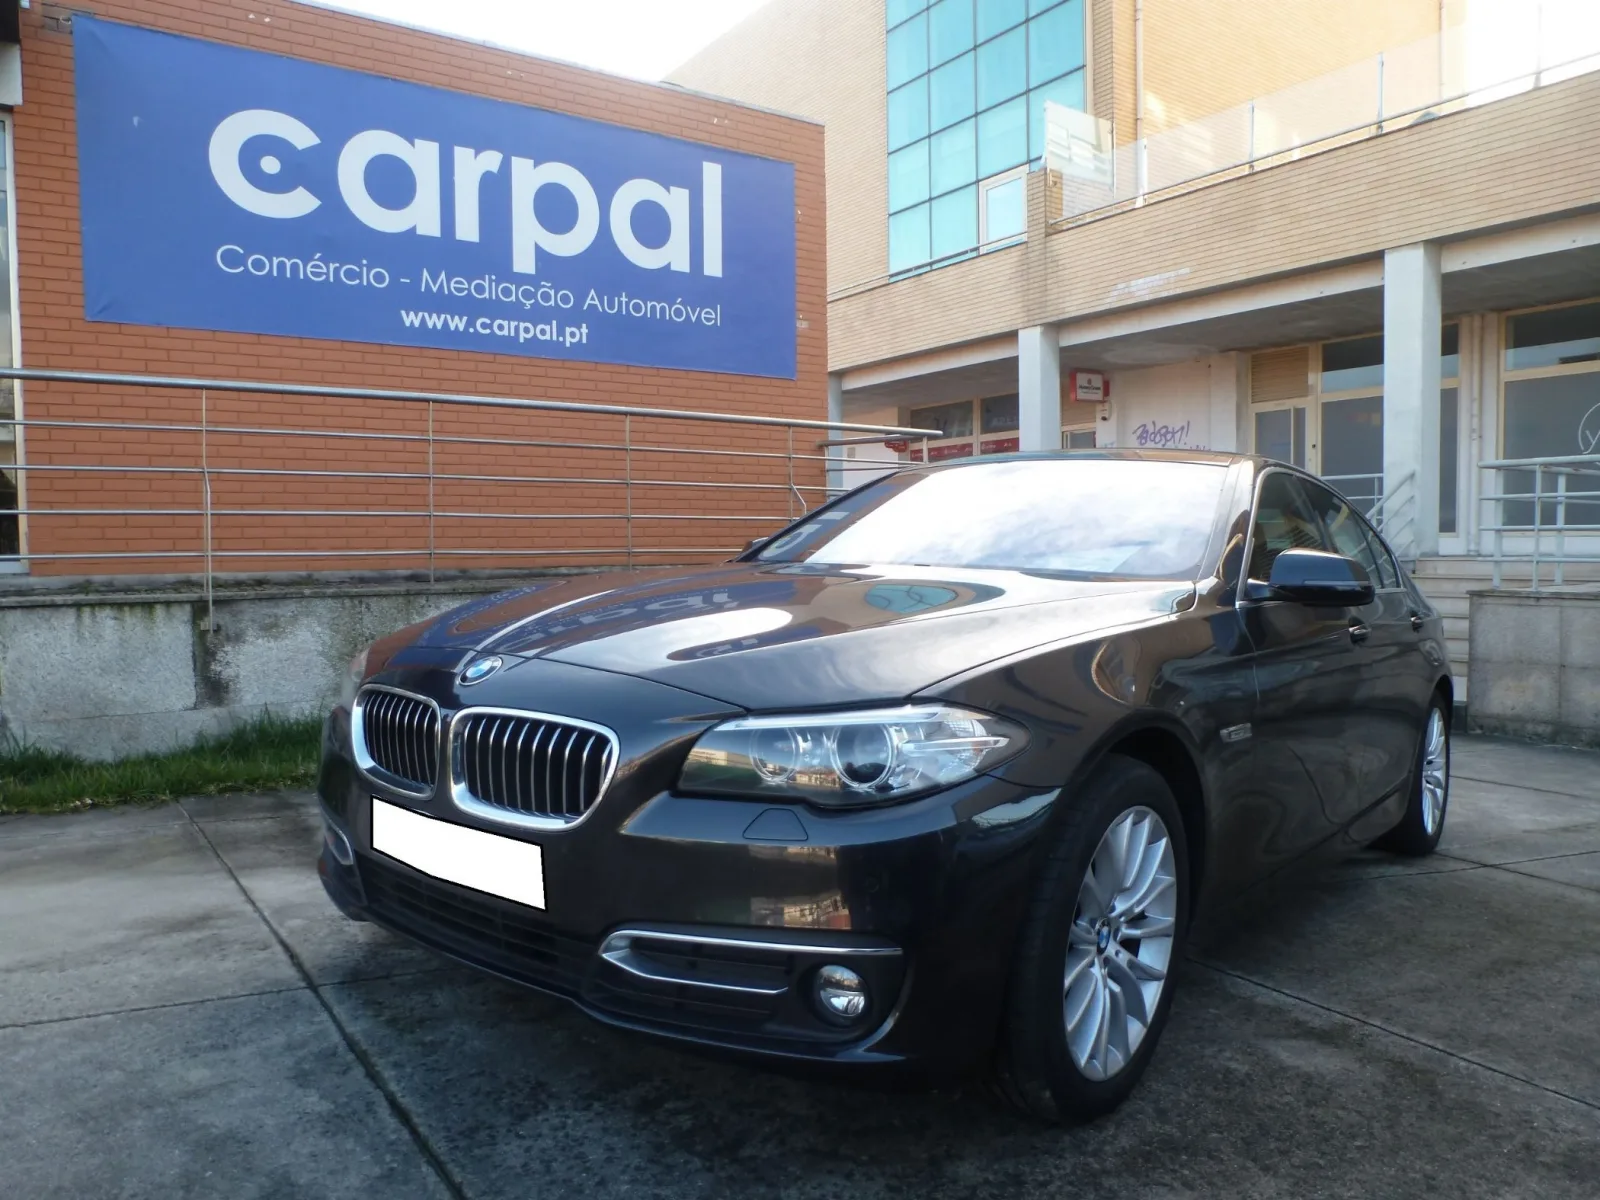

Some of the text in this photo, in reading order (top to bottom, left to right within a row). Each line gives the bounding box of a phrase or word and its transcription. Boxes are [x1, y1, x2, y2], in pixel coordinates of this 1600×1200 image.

[208, 109, 723, 278] carpal
[216, 244, 390, 288] Comércio
[420, 268, 575, 309] Mediação
[583, 288, 721, 326] Automóvel
[400, 309, 589, 347] www.carpal.pt
